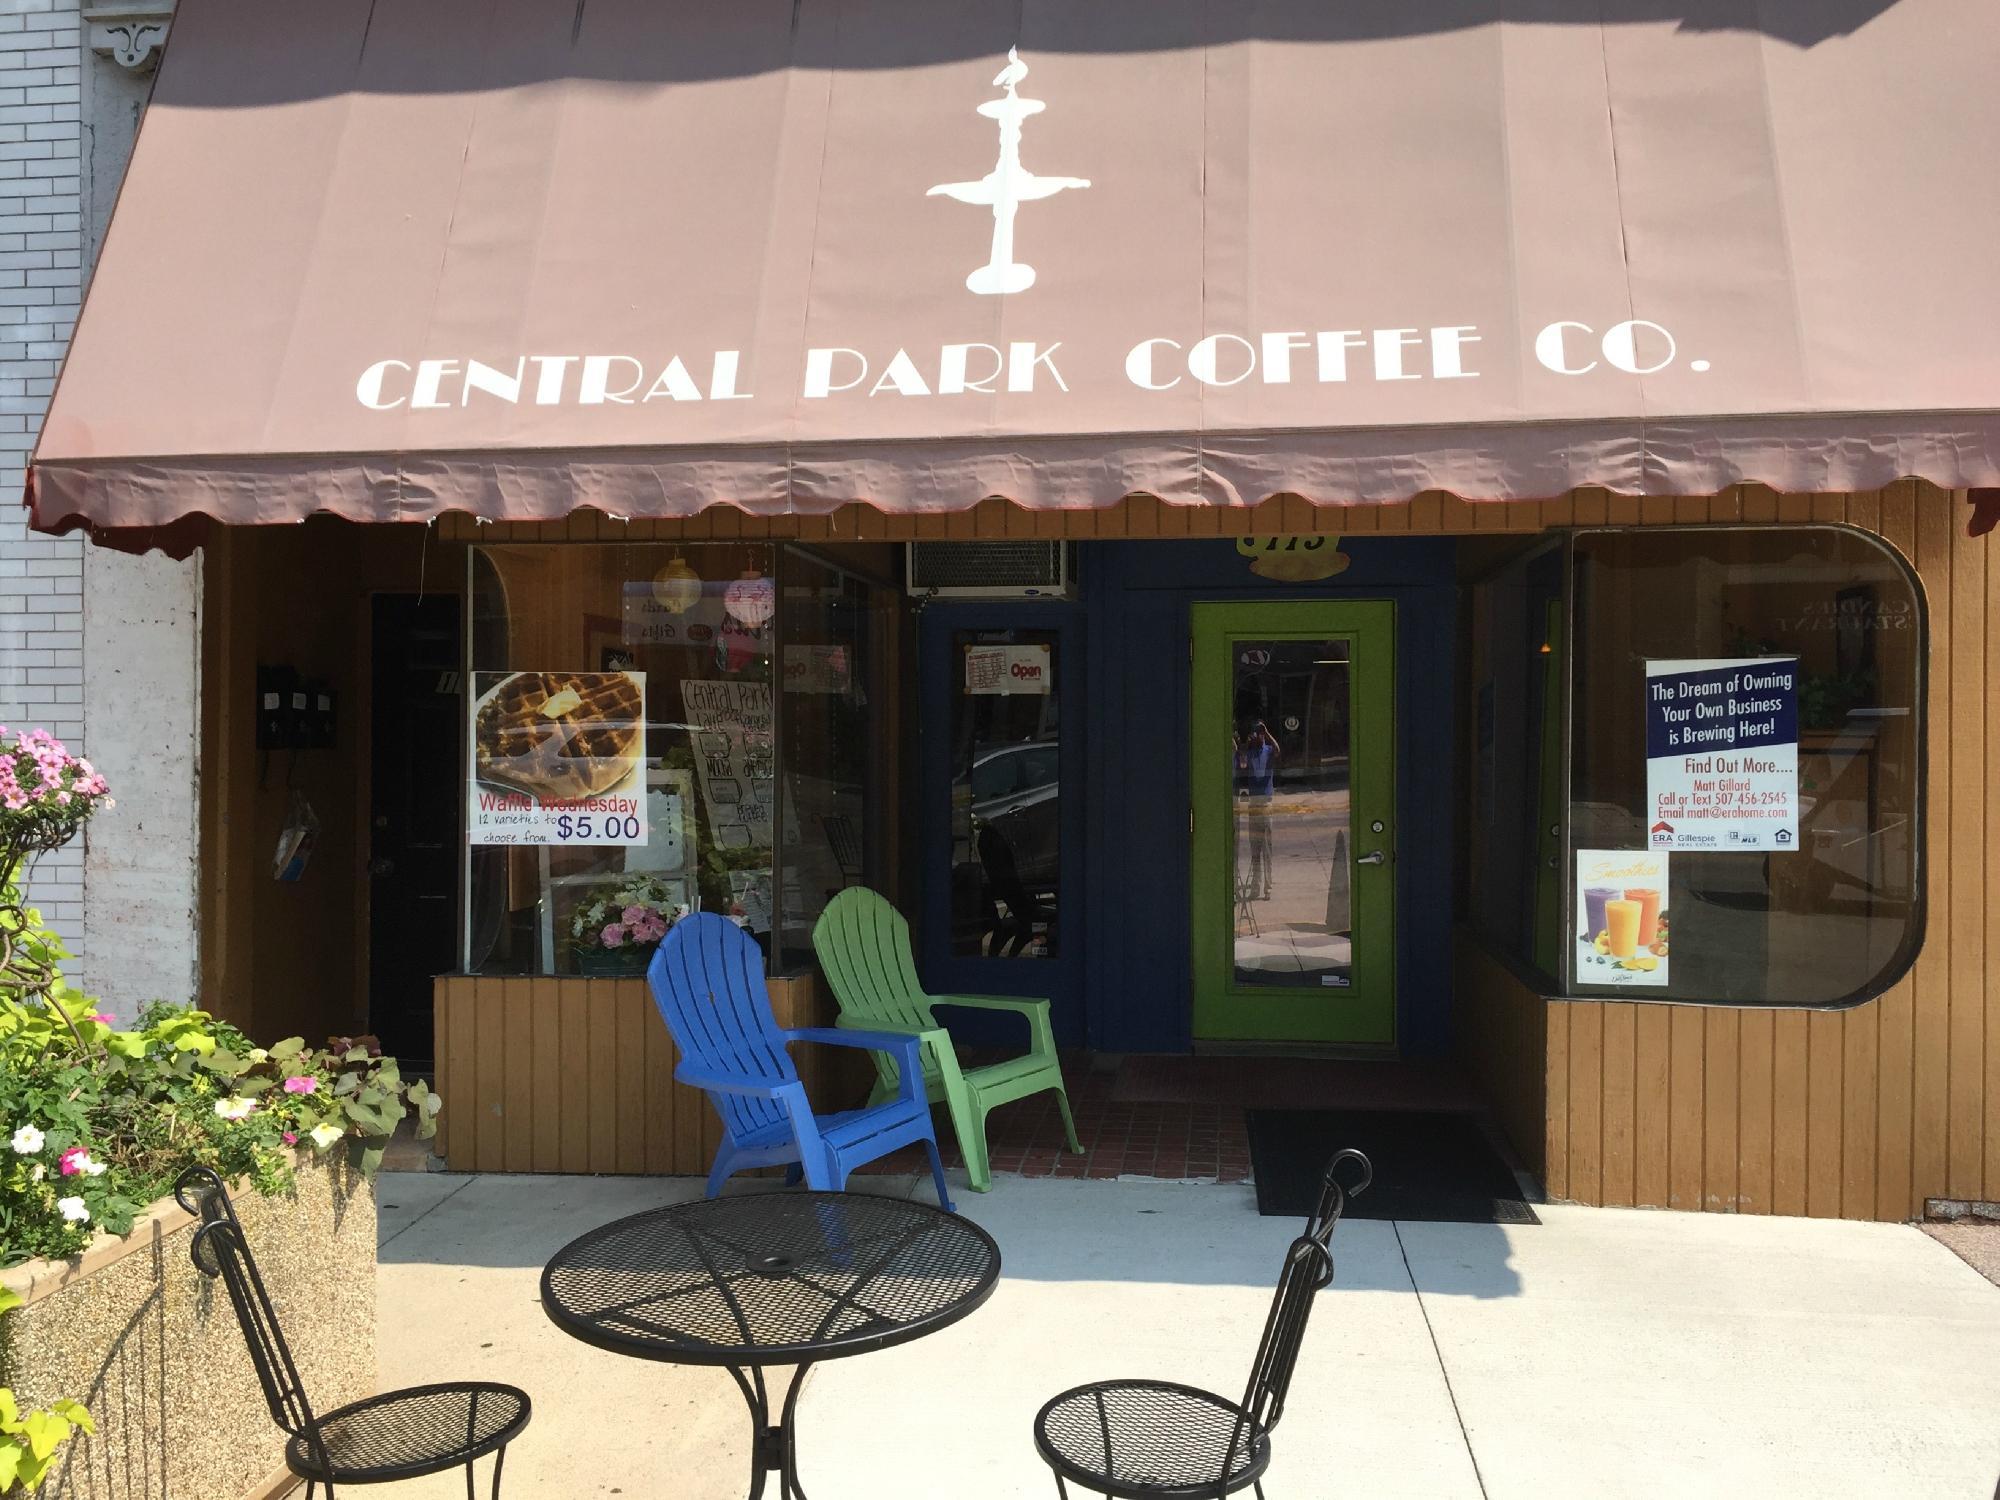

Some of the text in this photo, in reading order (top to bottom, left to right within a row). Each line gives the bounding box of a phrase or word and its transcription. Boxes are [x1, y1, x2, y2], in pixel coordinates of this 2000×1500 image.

[355, 320, 1711, 411] CENTRAL PARK COFFEE CO.
[1011, 663, 1042, 680] Open
[1652, 672, 1792, 701] The Dream of Owning
[1662, 698, 1782, 723] Your Own Business
[1669, 718, 1775, 745] is Brewing Here!
[1685, 757, 1711, 774] Find
[1716, 758, 1738, 774] Out
[1693, 778, 1750, 792] Matt Gillard
[479, 793, 638, 816] Waffle Wednesday
[1658, 792, 1787, 805] Call or Text 507-456-2545
[479, 814, 556, 825] 12 varieties to
[1658, 806, 1787, 818] Email matt@erahome.com
[557, 814, 640, 840] $5.00
[483, 831, 518, 843] choose
[1652, 834, 1673, 842] ERA
[1678, 834, 1716, 843] Gillespie
